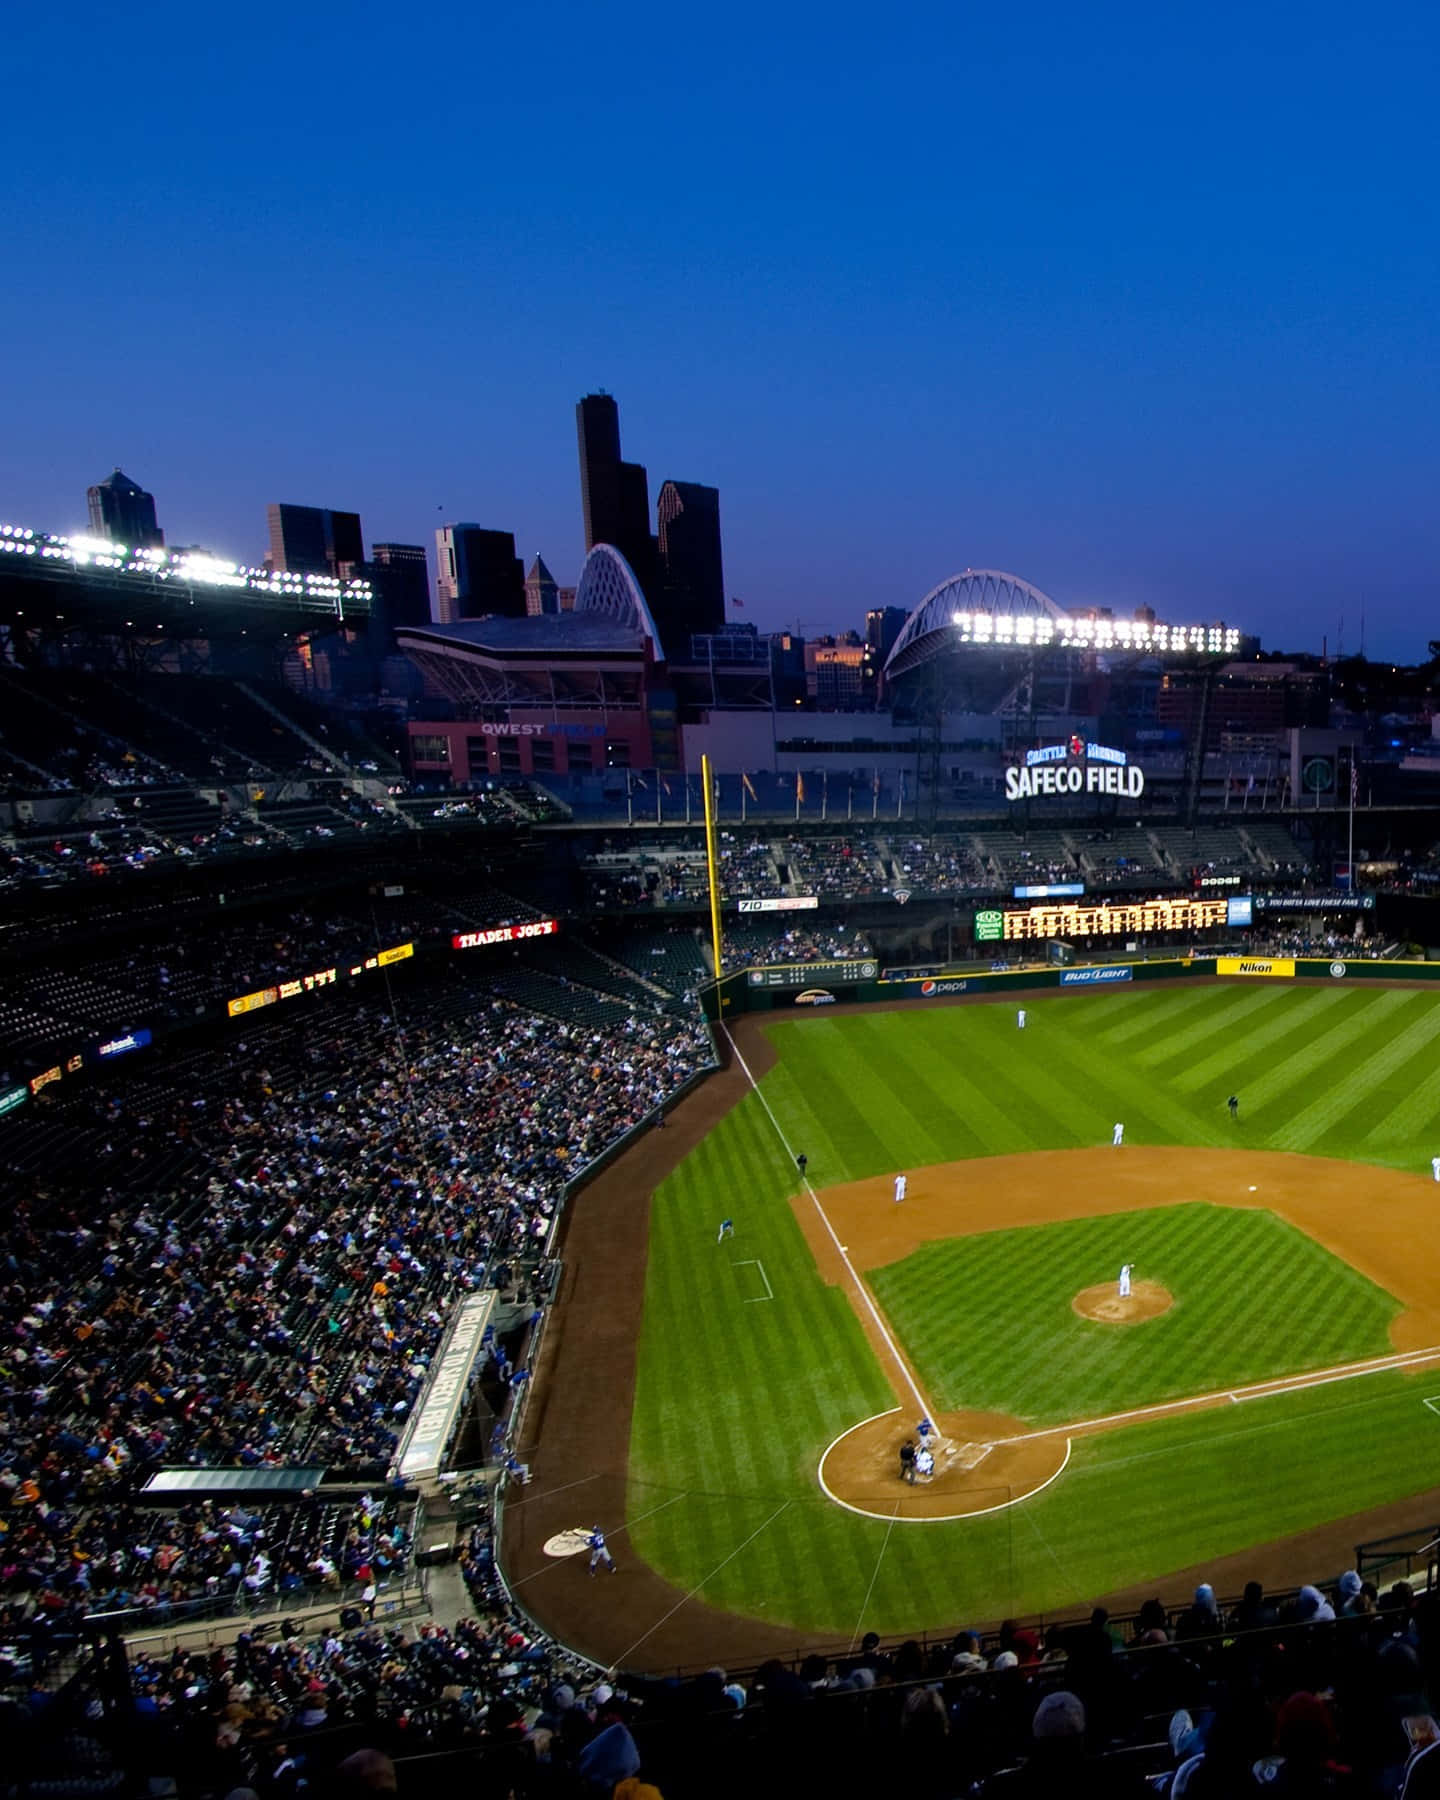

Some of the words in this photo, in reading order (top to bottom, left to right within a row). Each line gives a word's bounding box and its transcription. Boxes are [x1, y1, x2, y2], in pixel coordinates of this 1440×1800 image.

[481, 723, 544, 736] QWEST
[1005, 766, 1083, 801] SAFECO
[1087, 766, 1145, 798] FIELD
[1201, 877, 1240, 886] DODGE
[741, 901, 762, 911] 710
[459, 928, 513, 949] TRADER
[516, 921, 552, 939] JOE'S
[1240, 963, 1272, 973] Nikon
[1064, 972, 1092, 981] BUD
[937, 980, 967, 993] pepsi
[446, 1305, 486, 1352] WELCOME
[440, 1351, 469, 1368] TO
[427, 1366, 464, 1407] SAFECO
[415, 1408, 448, 1442] FIELD
